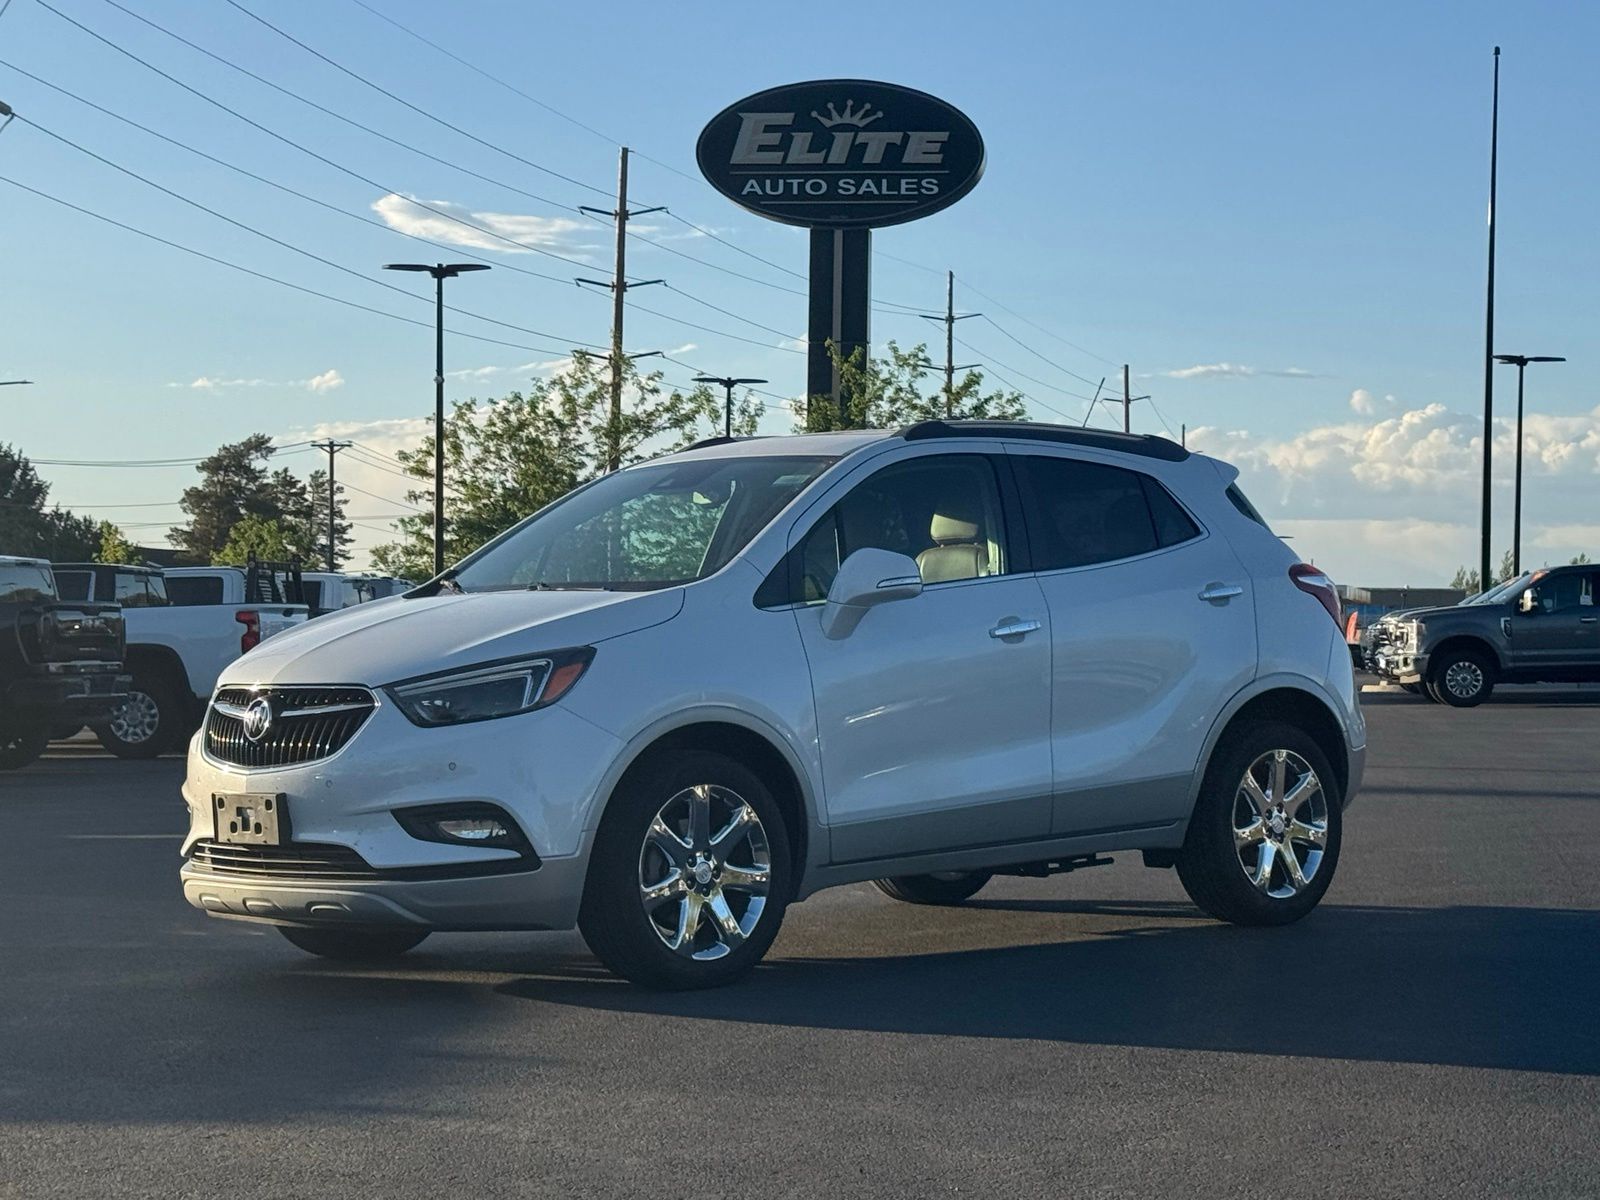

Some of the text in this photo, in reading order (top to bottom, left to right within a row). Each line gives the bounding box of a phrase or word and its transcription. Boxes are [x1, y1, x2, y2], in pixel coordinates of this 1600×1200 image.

[729, 112, 950, 164] ELITE
[741, 178, 939, 195] AUTO SALES
